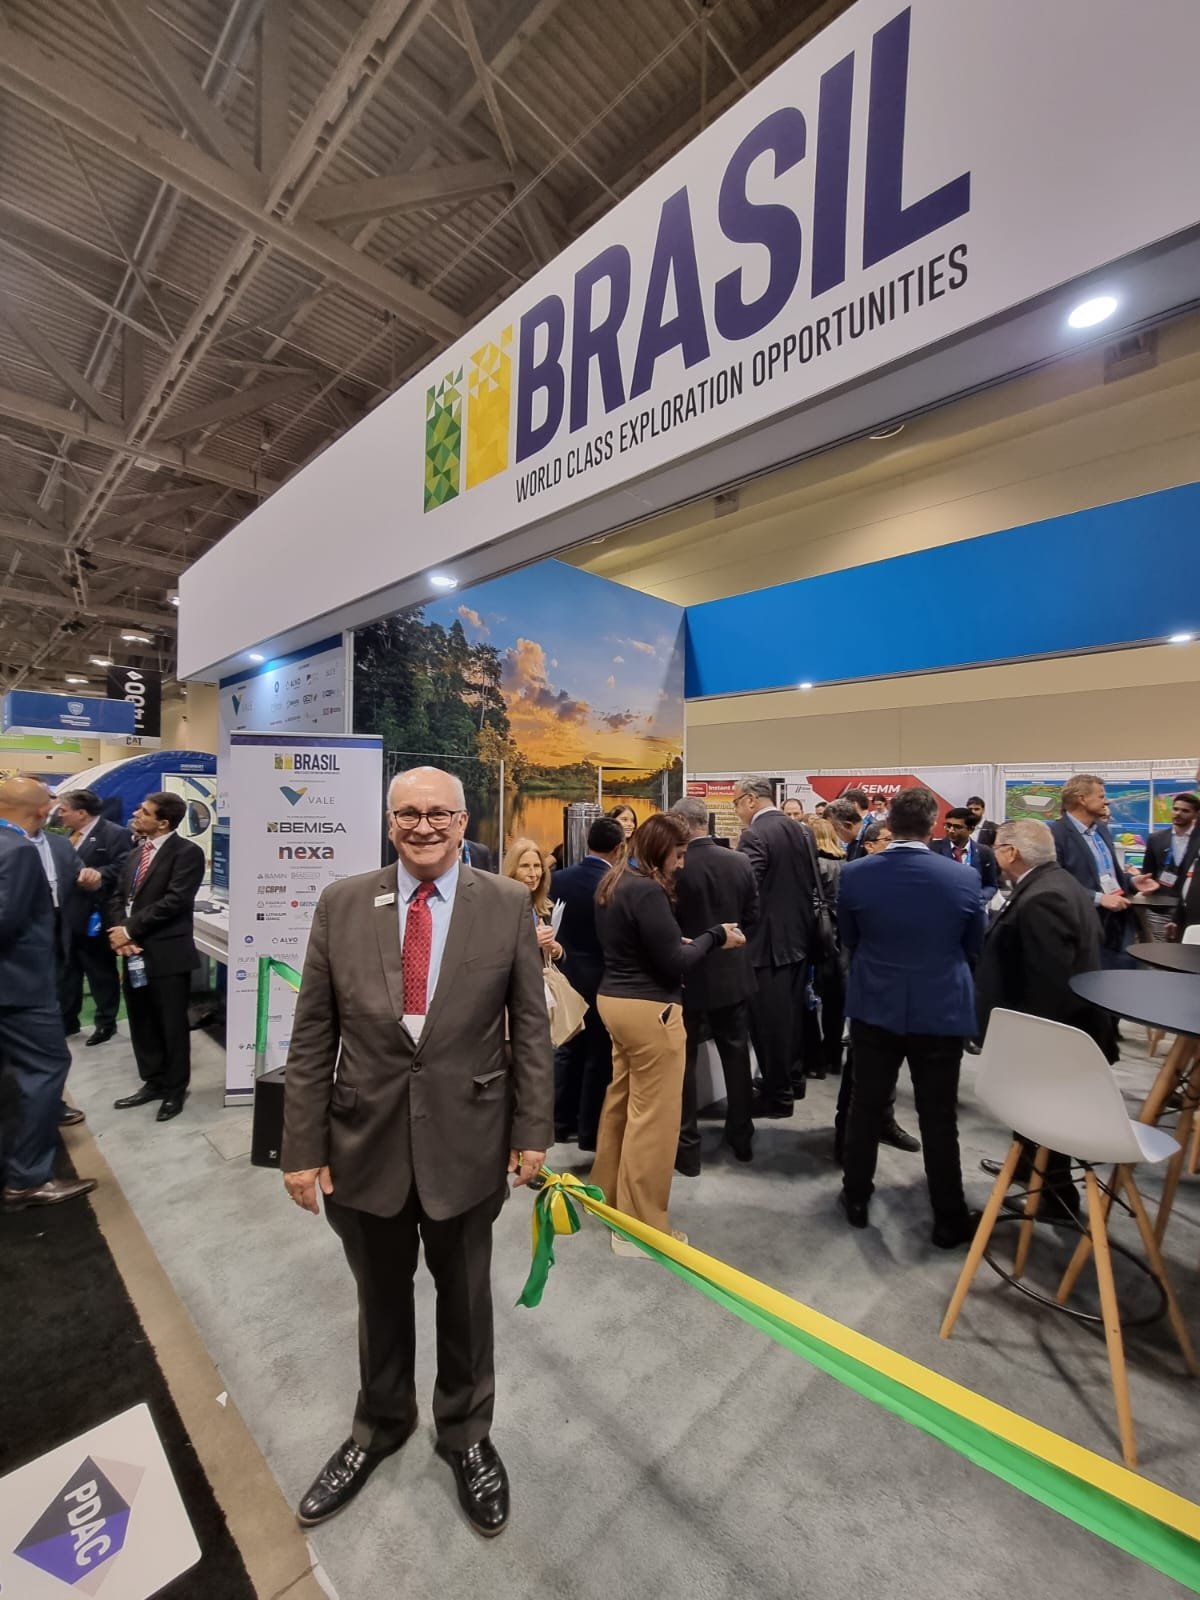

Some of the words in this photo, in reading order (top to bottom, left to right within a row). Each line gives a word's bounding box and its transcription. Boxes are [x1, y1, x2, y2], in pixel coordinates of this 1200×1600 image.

[516, 5, 971, 463] BRASIL
[516, 458, 562, 503] WORLD
[567, 435, 614, 484] CLASS
[620, 361, 743, 461] EXPLORATION
[752, 243, 969, 387] OPPORTUNITIES
[294, 753, 340, 771] BRASIL
[308, 796, 335, 805] VALE
[280, 822, 347, 833] BEMISA
[279, 846, 335, 860] nexa
[64, 1479, 112, 1566] PDAC
